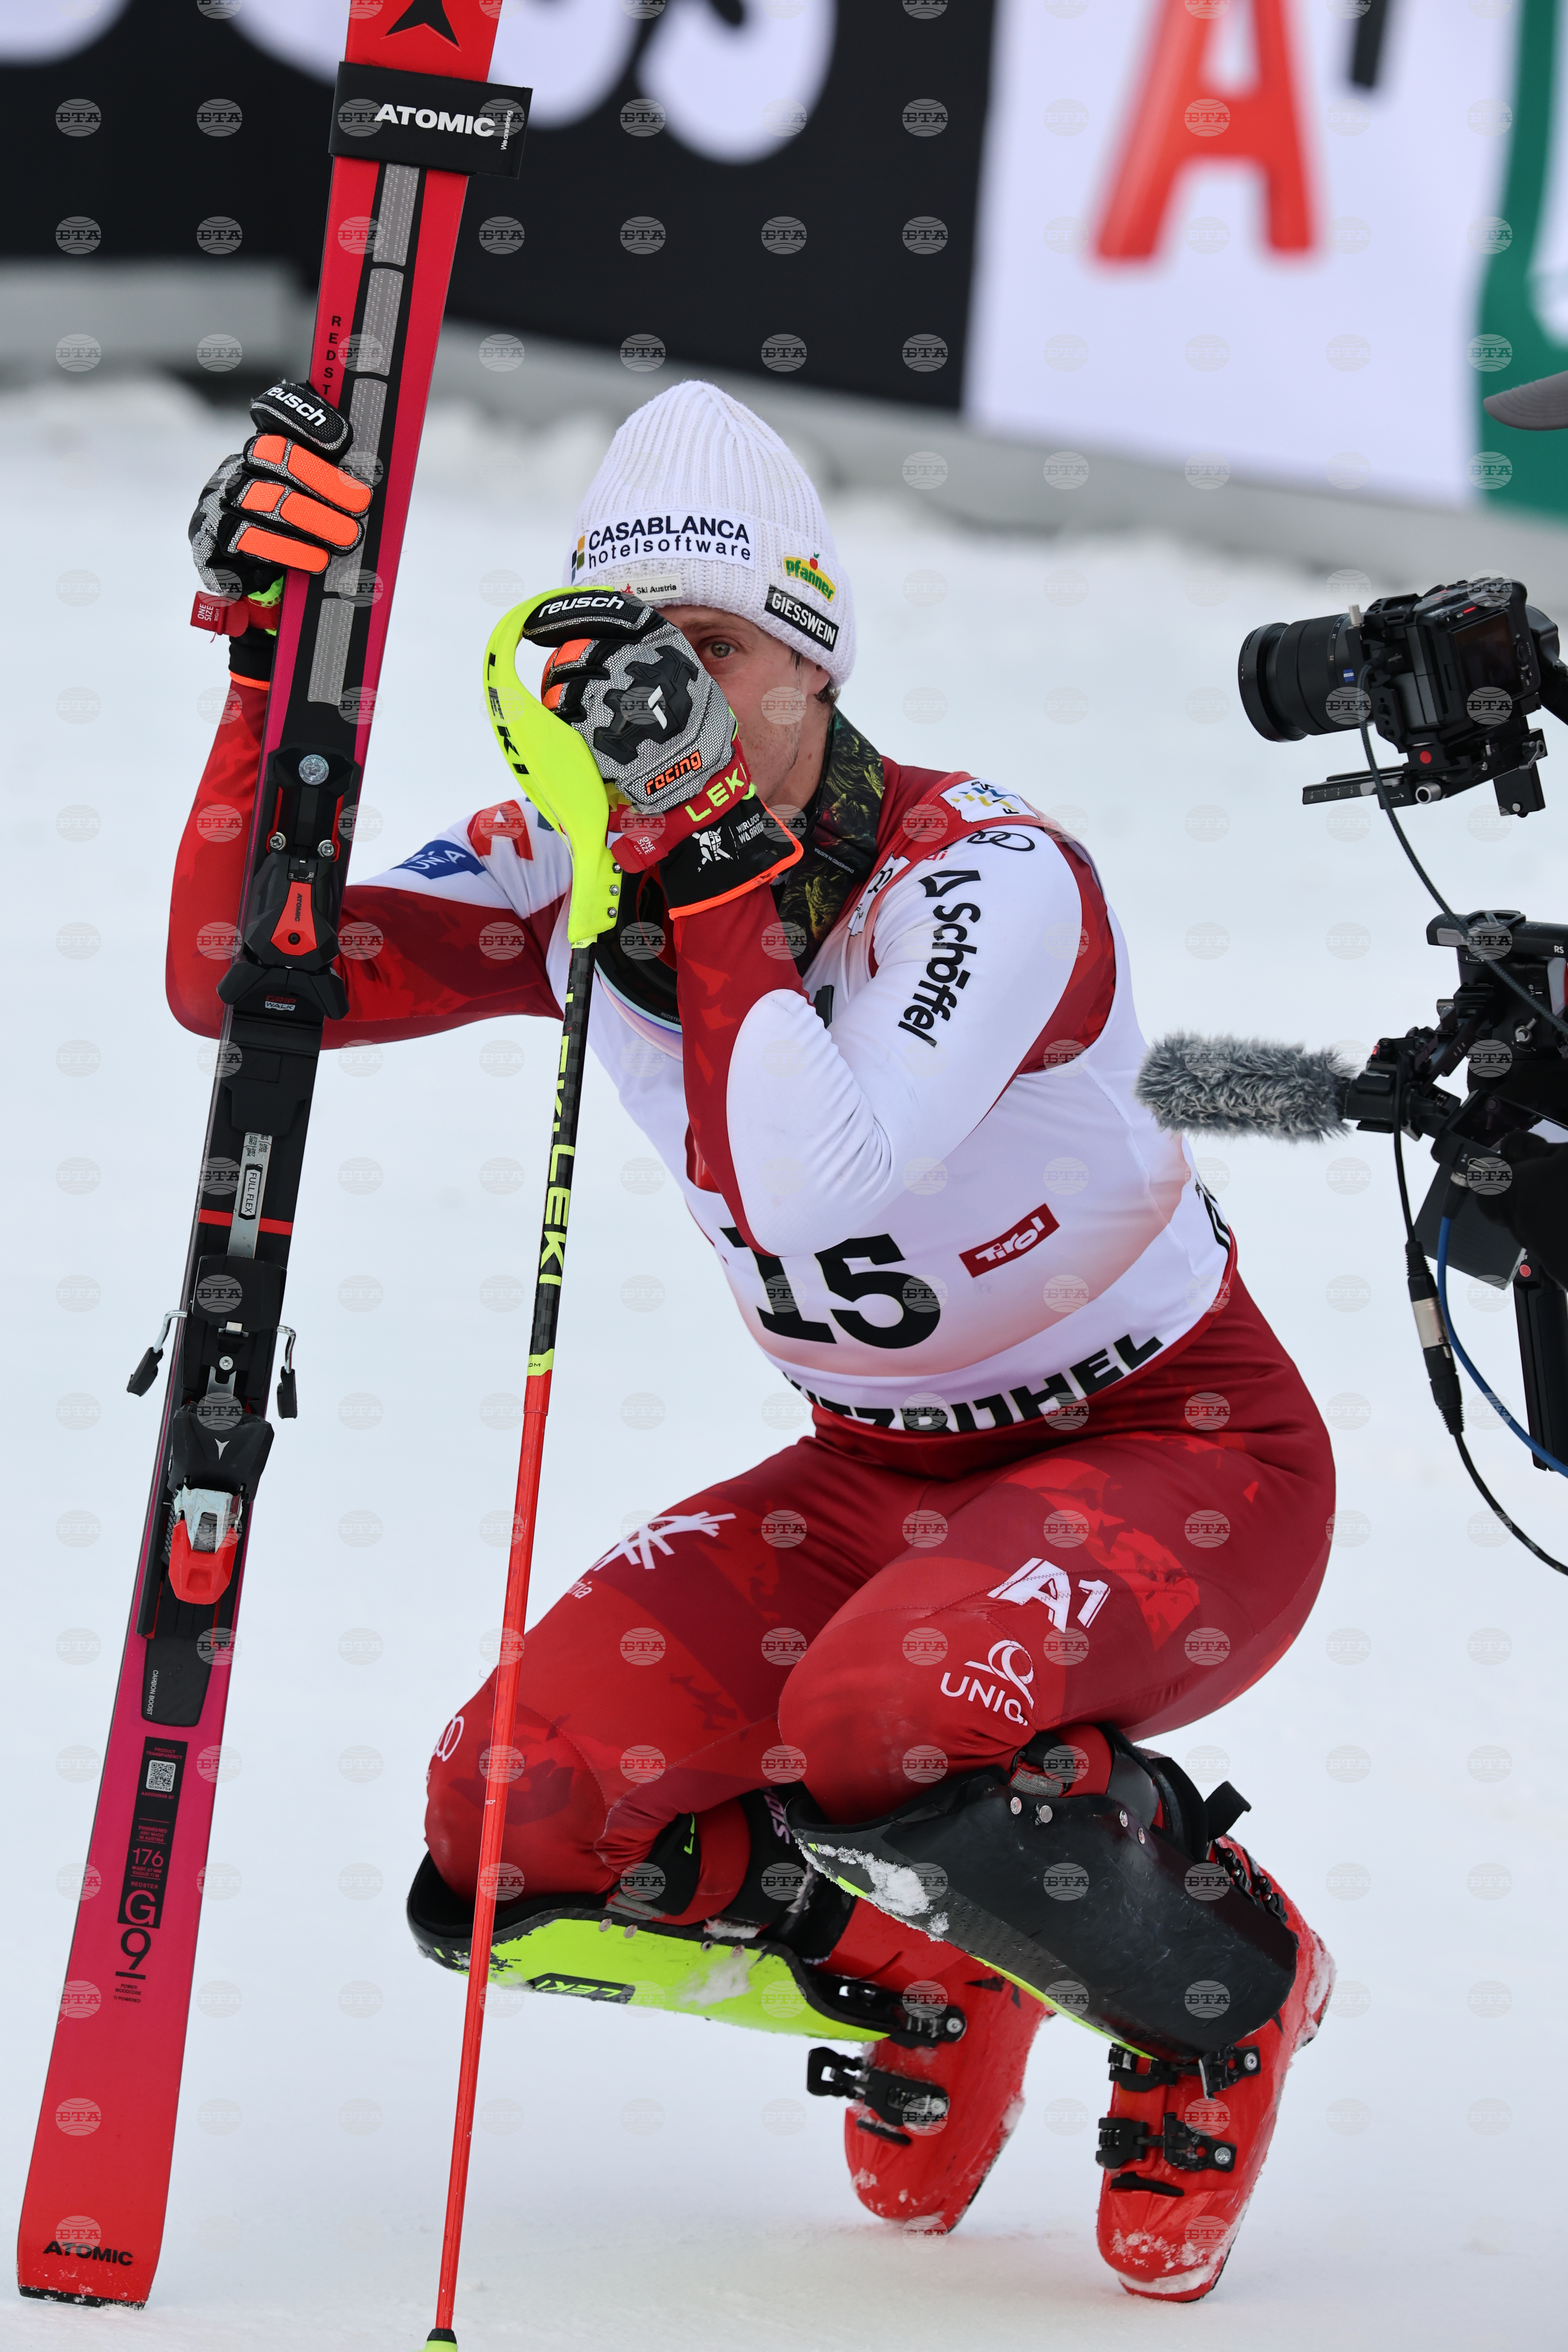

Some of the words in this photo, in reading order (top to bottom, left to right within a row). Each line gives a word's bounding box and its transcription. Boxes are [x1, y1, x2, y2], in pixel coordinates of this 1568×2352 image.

[374, 103, 495, 137] ATOMIC
[323, 316, 341, 395] REDST
[265, 387, 327, 426] eusch
[588, 515, 750, 550] CASABLANCA
[588, 535, 750, 569] hotelsoftware
[636, 586, 648, 595] Ski
[650, 584, 677, 593] Austria
[786, 559, 834, 599] pfanner
[197, 603, 207, 619] ONE
[204, 605, 214, 622] SIZE
[538, 595, 625, 619] reusch
[771, 592, 836, 645] GIESSWEIN
[486, 653, 530, 775] LEKI
[645, 749, 702, 796] racing
[633, 845, 642, 855] LEFT
[637, 839, 651, 855] SIZE
[643, 837, 656, 852] ONE
[832, 858, 855, 874] ENGINEERED
[1553, 945, 1564, 954] RS
[898, 902, 981, 1048] Schöffel
[266, 995, 297, 1004] GRIP
[247, 1172, 257, 1192] FULL
[245, 1193, 254, 1213] FLEX
[539, 1144, 575, 1287] LEKI
[975, 1216, 1045, 1262] Tirol
[987, 1557, 1111, 1633] A1
[150, 1670, 159, 1695] CARBON
[147, 1695, 155, 1715] BOOST
[940, 1672, 1028, 1726] UNIQ
[146, 1751, 183, 1760] TRANSPARENCY
[138, 1825, 168, 1834] ENGINEERED
[132, 1847, 164, 1867] 176
[131, 1881, 159, 1889] REDSTER
[124, 1889, 156, 1926] G
[120, 1927, 151, 1970] 9
[43, 2240, 133, 2266] ATOMIC
